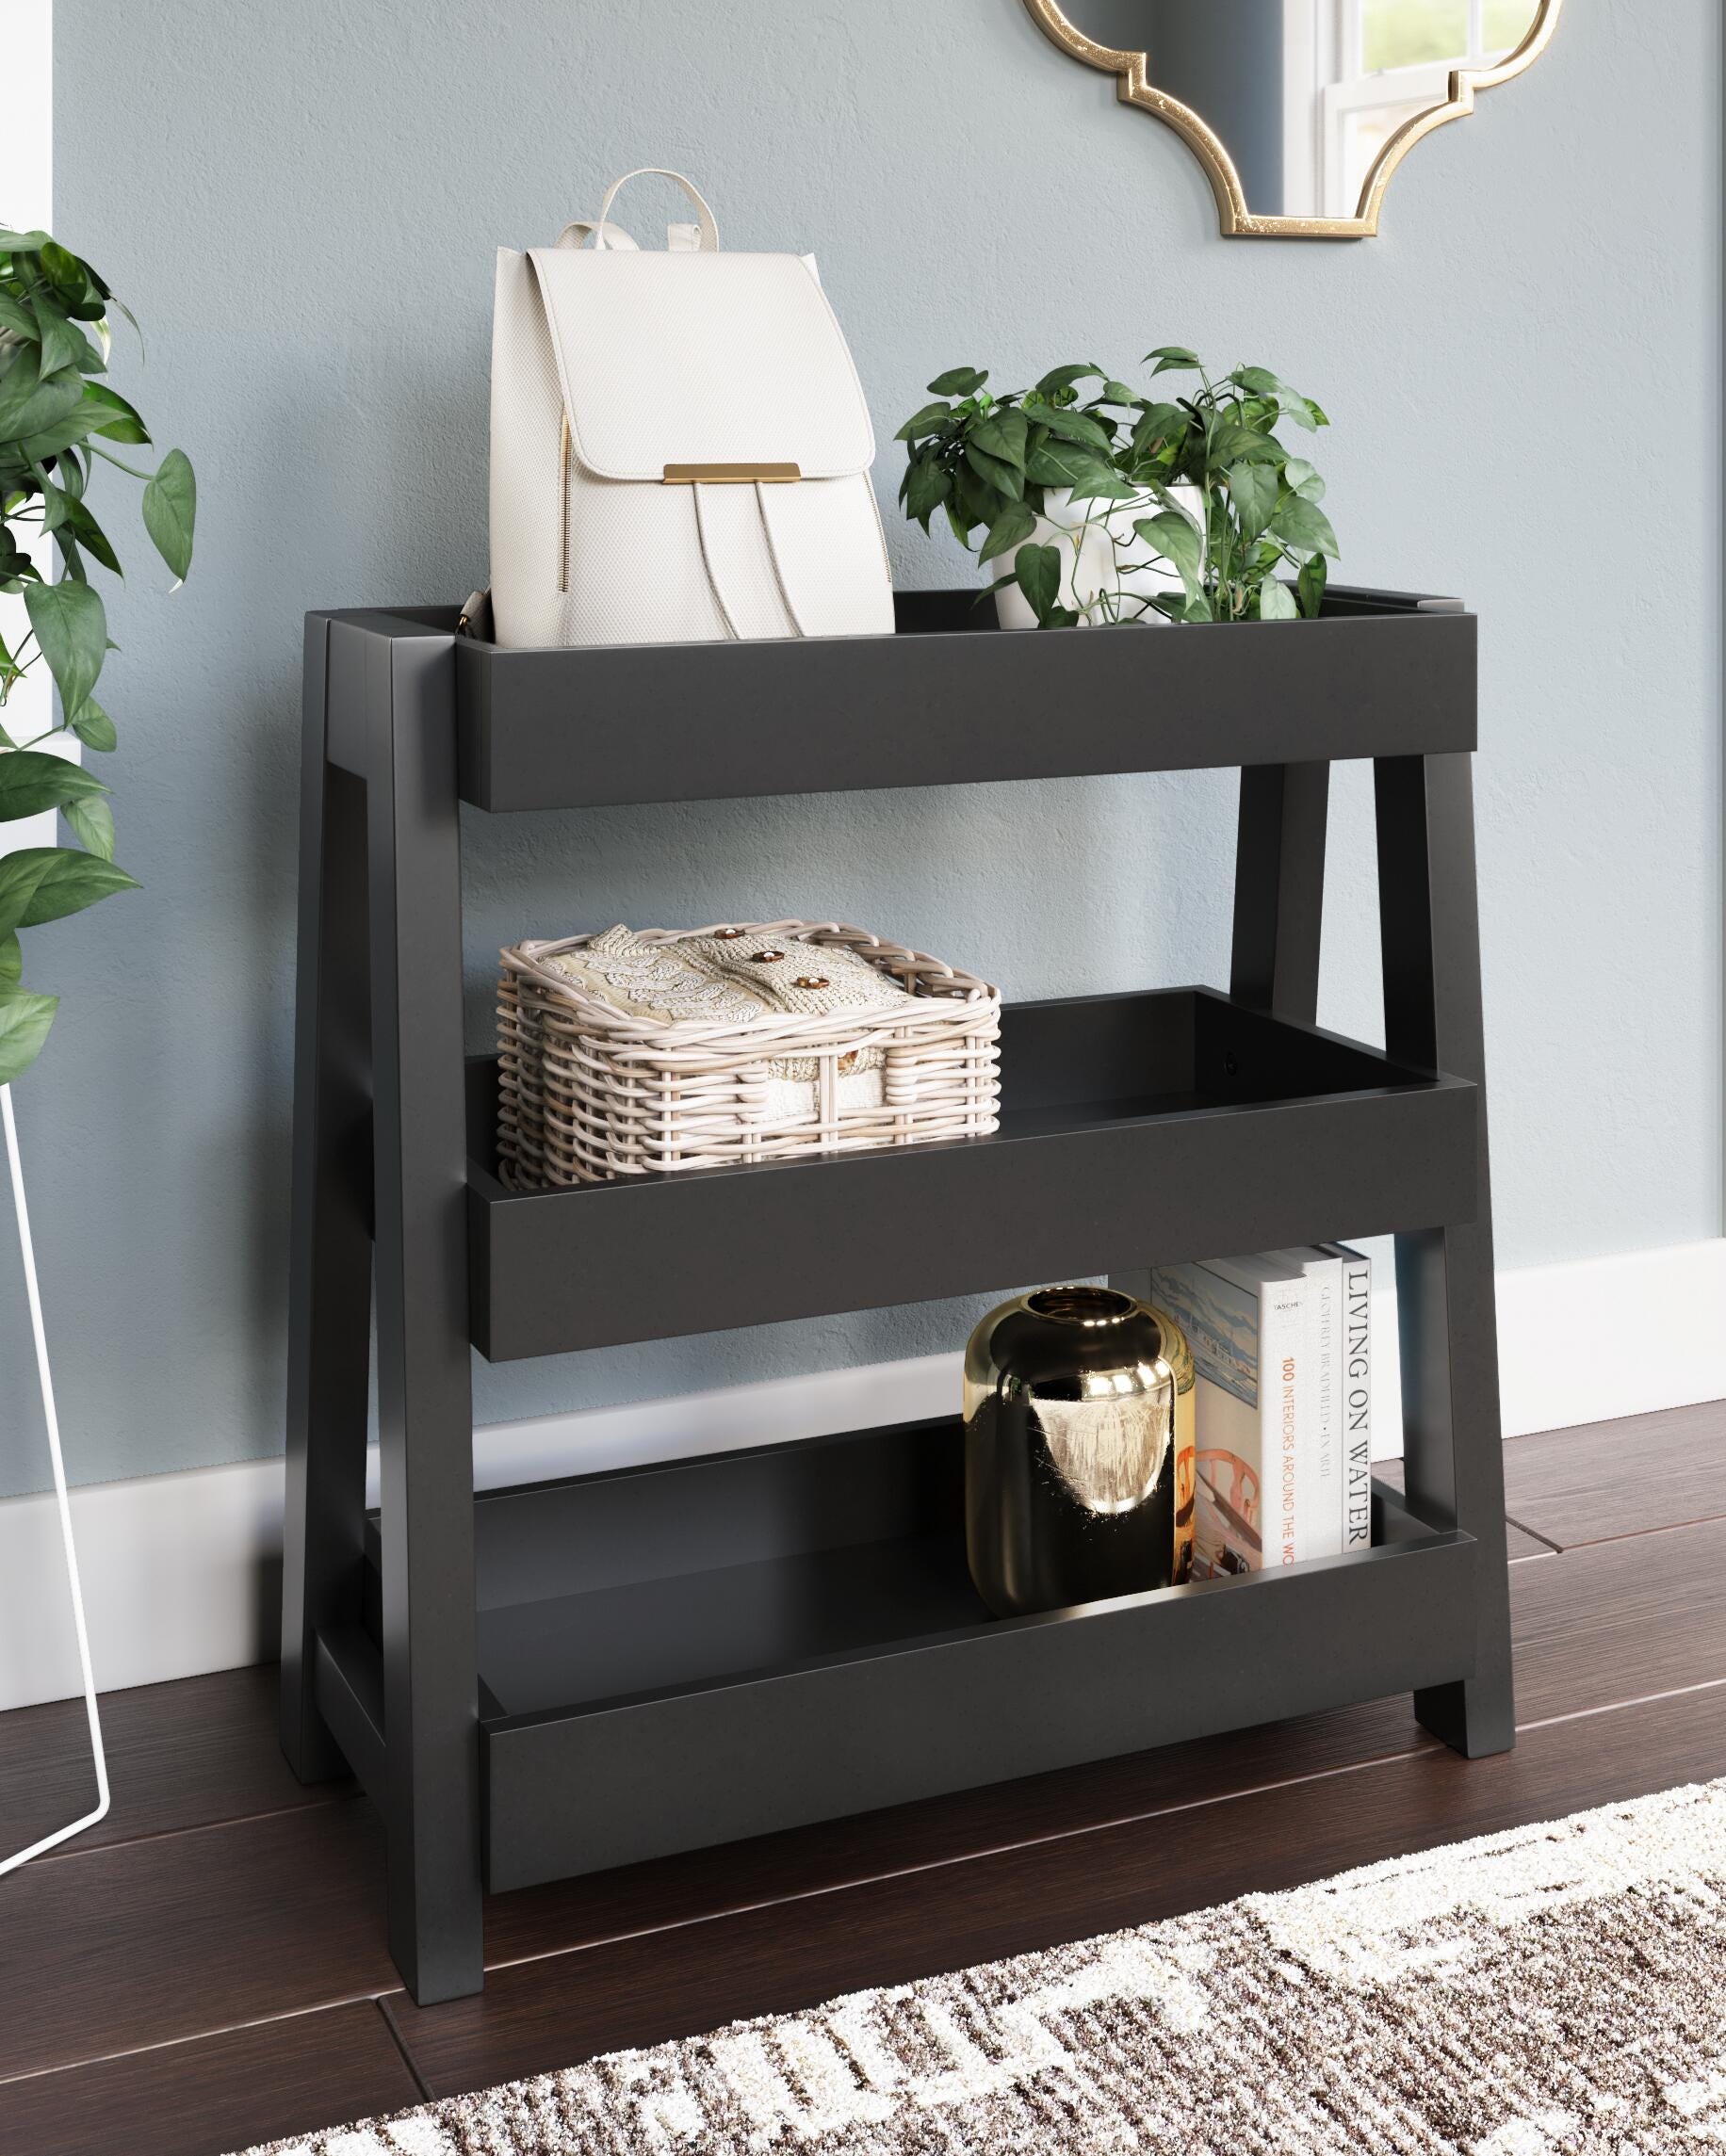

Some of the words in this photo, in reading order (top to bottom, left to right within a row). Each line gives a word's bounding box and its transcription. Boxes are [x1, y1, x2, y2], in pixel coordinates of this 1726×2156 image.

[1348, 1270, 1368, 1379] LIVING
[1282, 1356, 1295, 1382] 100
[1282, 1386, 1295, 1451] INTERIORS
[1348, 1389, 1368, 1431] ON
[1282, 1455, 1294, 1512] AROUND
[1348, 1440, 1368, 1546] WATER
[1282, 1516, 1294, 1540] THE
